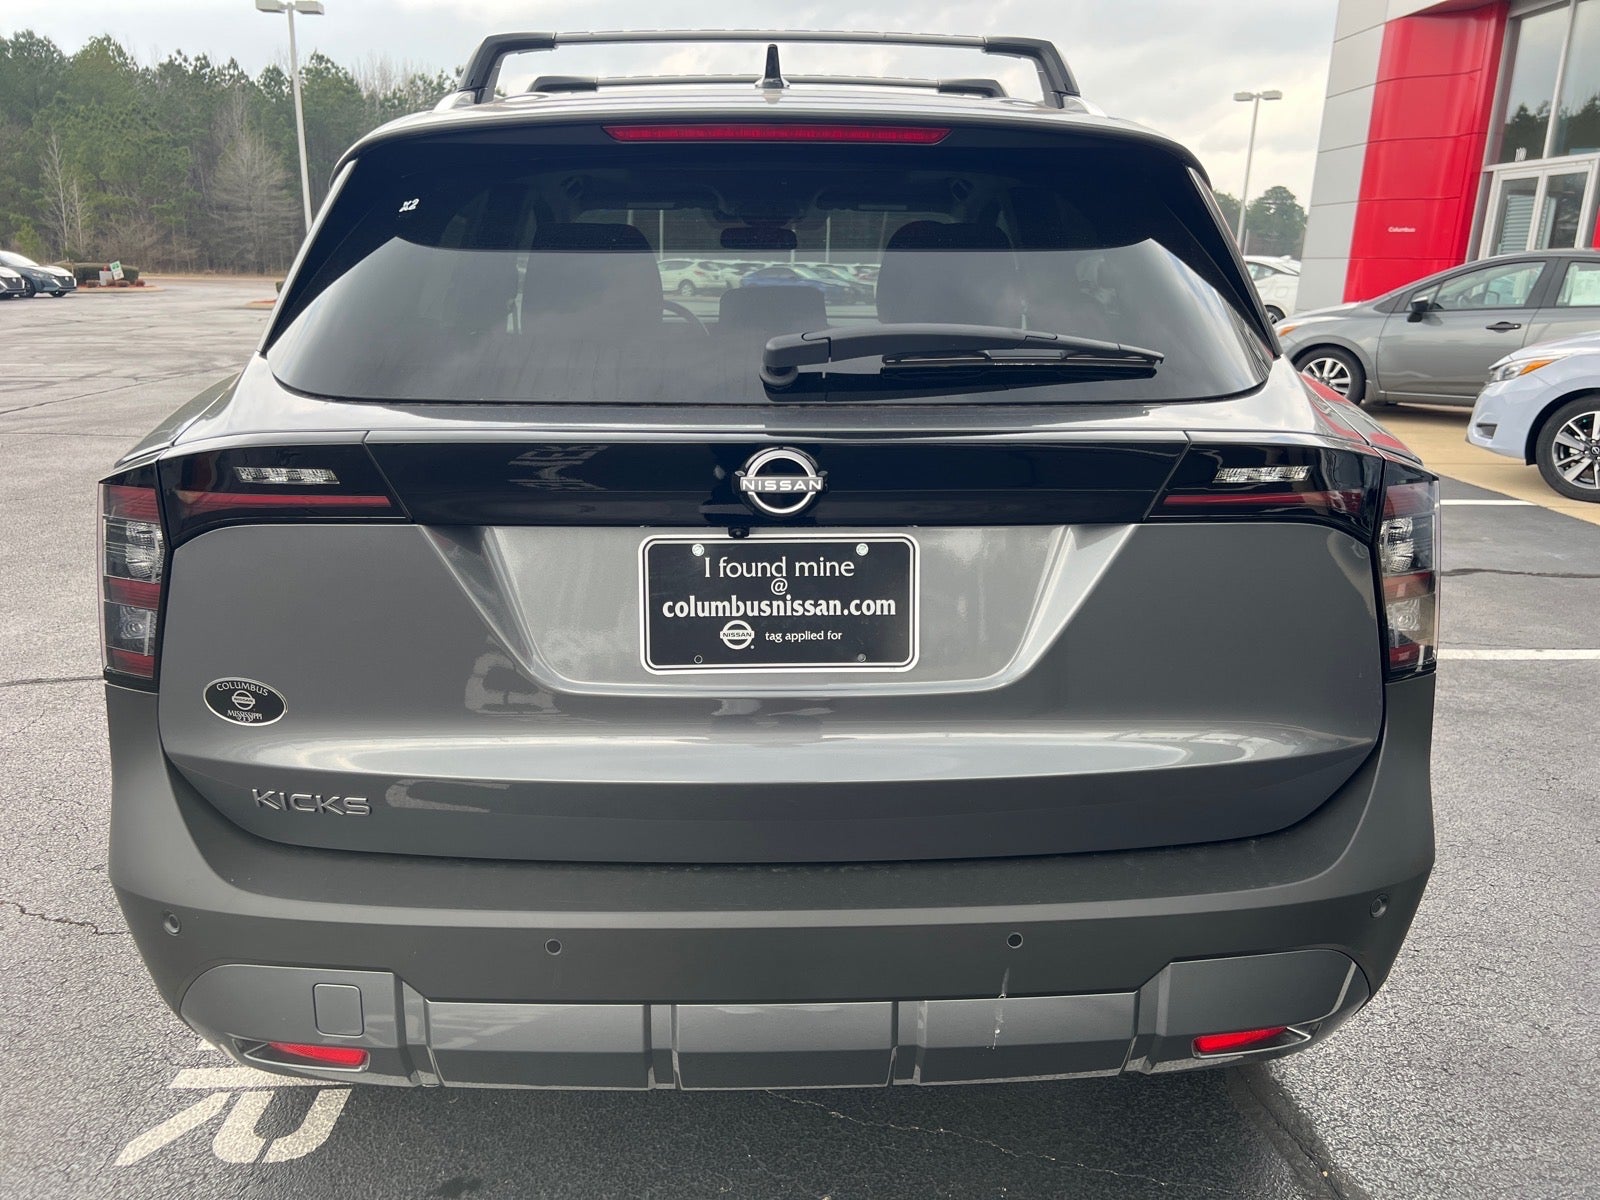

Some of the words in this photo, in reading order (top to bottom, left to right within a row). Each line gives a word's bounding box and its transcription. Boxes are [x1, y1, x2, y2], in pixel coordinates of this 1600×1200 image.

[741, 478, 822, 492] NISSAN
[704, 557, 711, 578] I
[719, 556, 787, 578] found
[795, 556, 855, 578] mine
[770, 577, 788, 596] @
[662, 594, 896, 618] columbusnissan.com
[722, 631, 752, 639] NISSAN
[765, 631, 783, 643] tag
[785, 630, 824, 643] applied
[827, 630, 843, 641] for
[216, 681, 269, 697] COLUMBUS
[251, 788, 373, 816] KICKS
